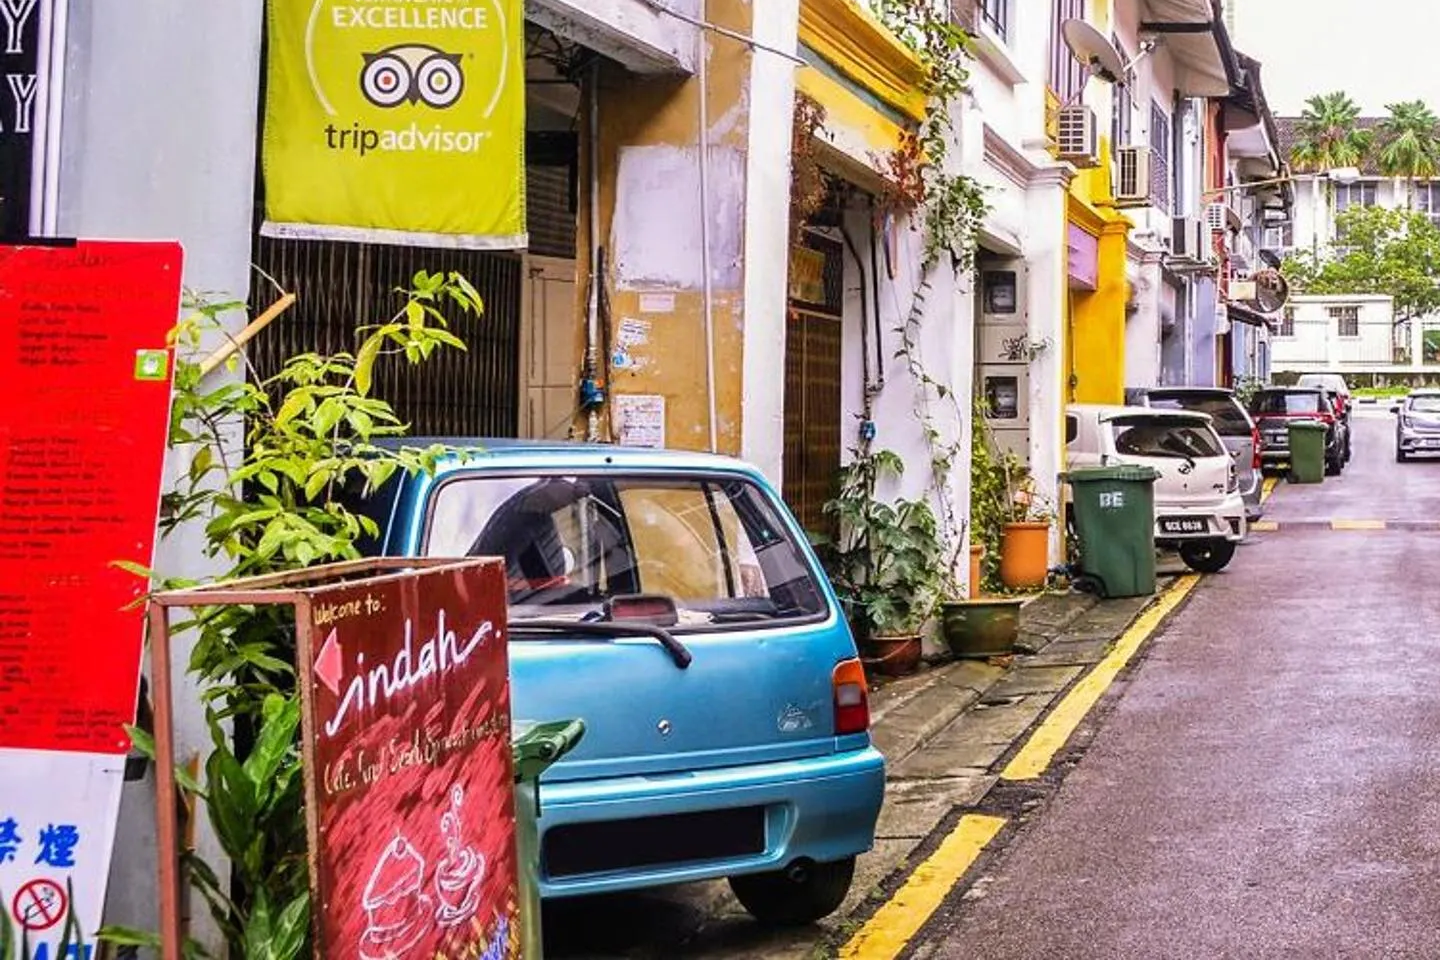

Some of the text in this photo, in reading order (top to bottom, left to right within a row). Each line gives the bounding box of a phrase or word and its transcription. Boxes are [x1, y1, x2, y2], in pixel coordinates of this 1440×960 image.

[332, 4, 488, 30] EXCELLENCE
[324, 122, 485, 157] tripadvisor
[313, 598, 361, 625] Welcome
